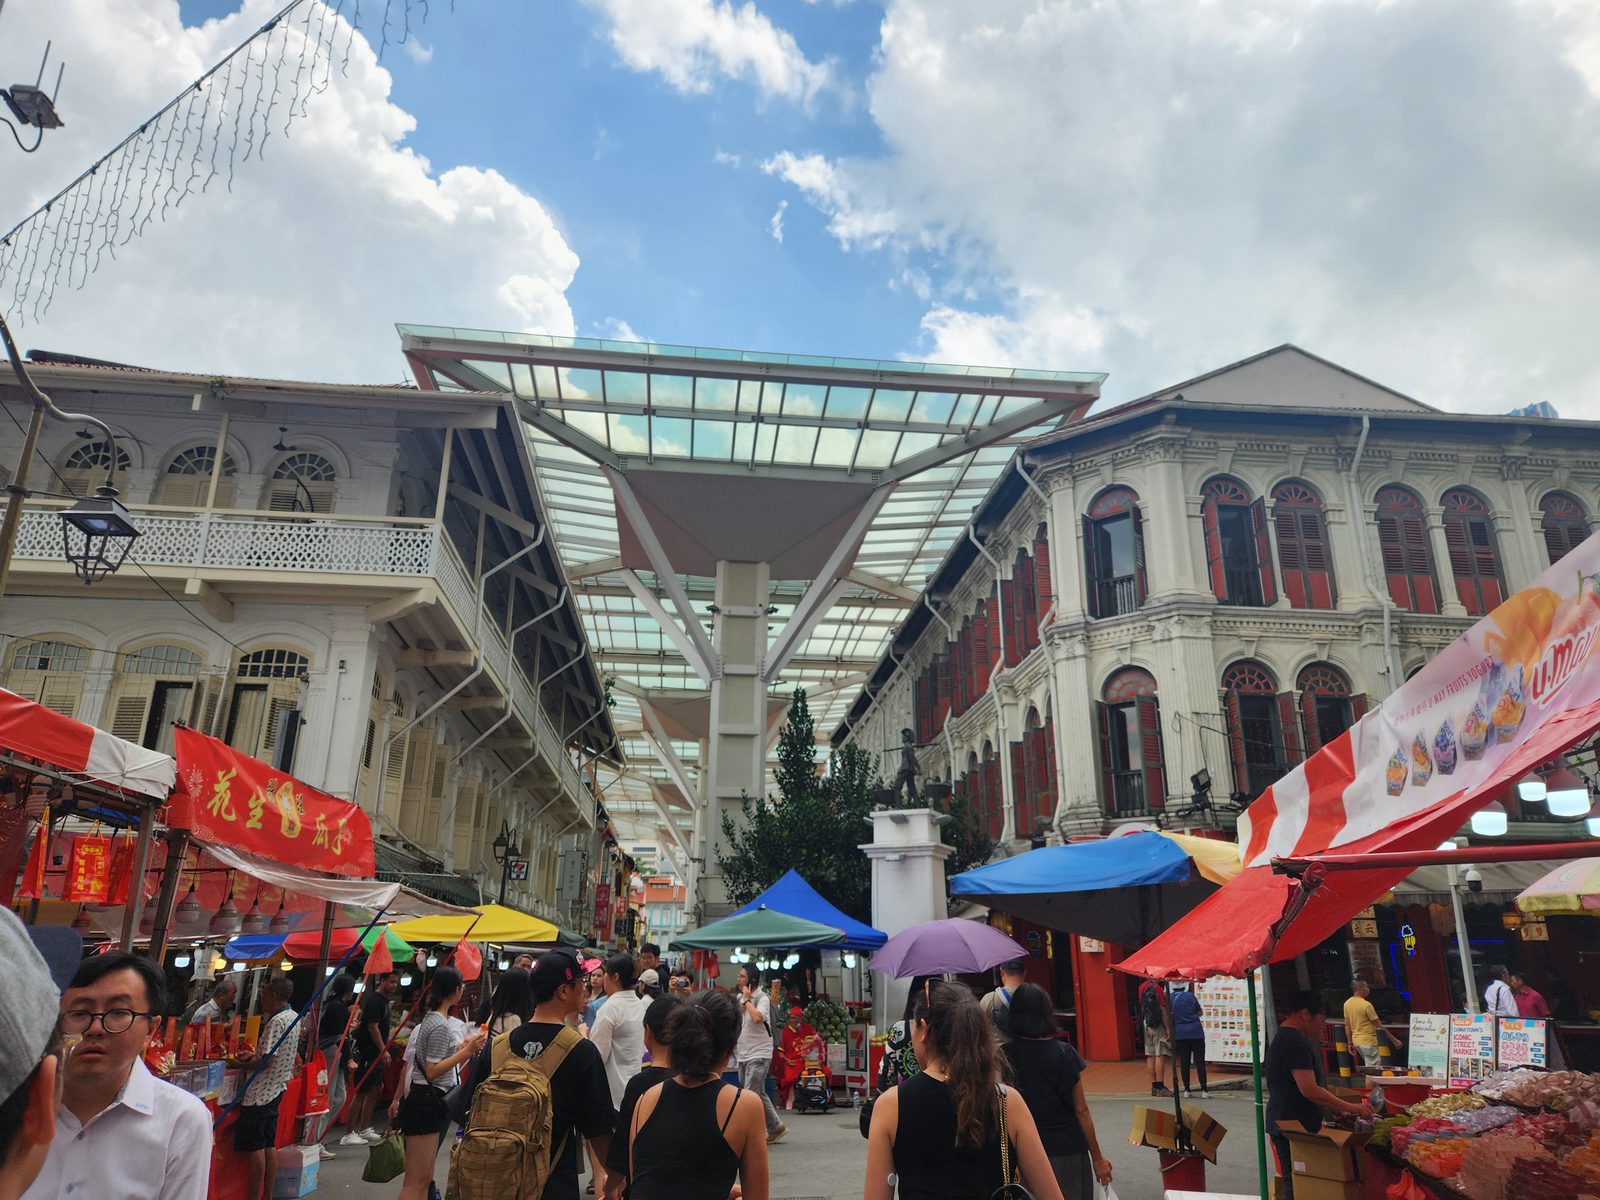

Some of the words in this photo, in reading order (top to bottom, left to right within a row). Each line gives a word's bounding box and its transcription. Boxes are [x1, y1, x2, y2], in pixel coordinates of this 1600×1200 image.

[1434, 688, 1445, 705] MAY
[1446, 674, 1469, 697] FRUITS
[1467, 655, 1494, 682] YOGURT
[207, 767, 267, 830] 花生
[850, 1030, 864, 1070] 7
